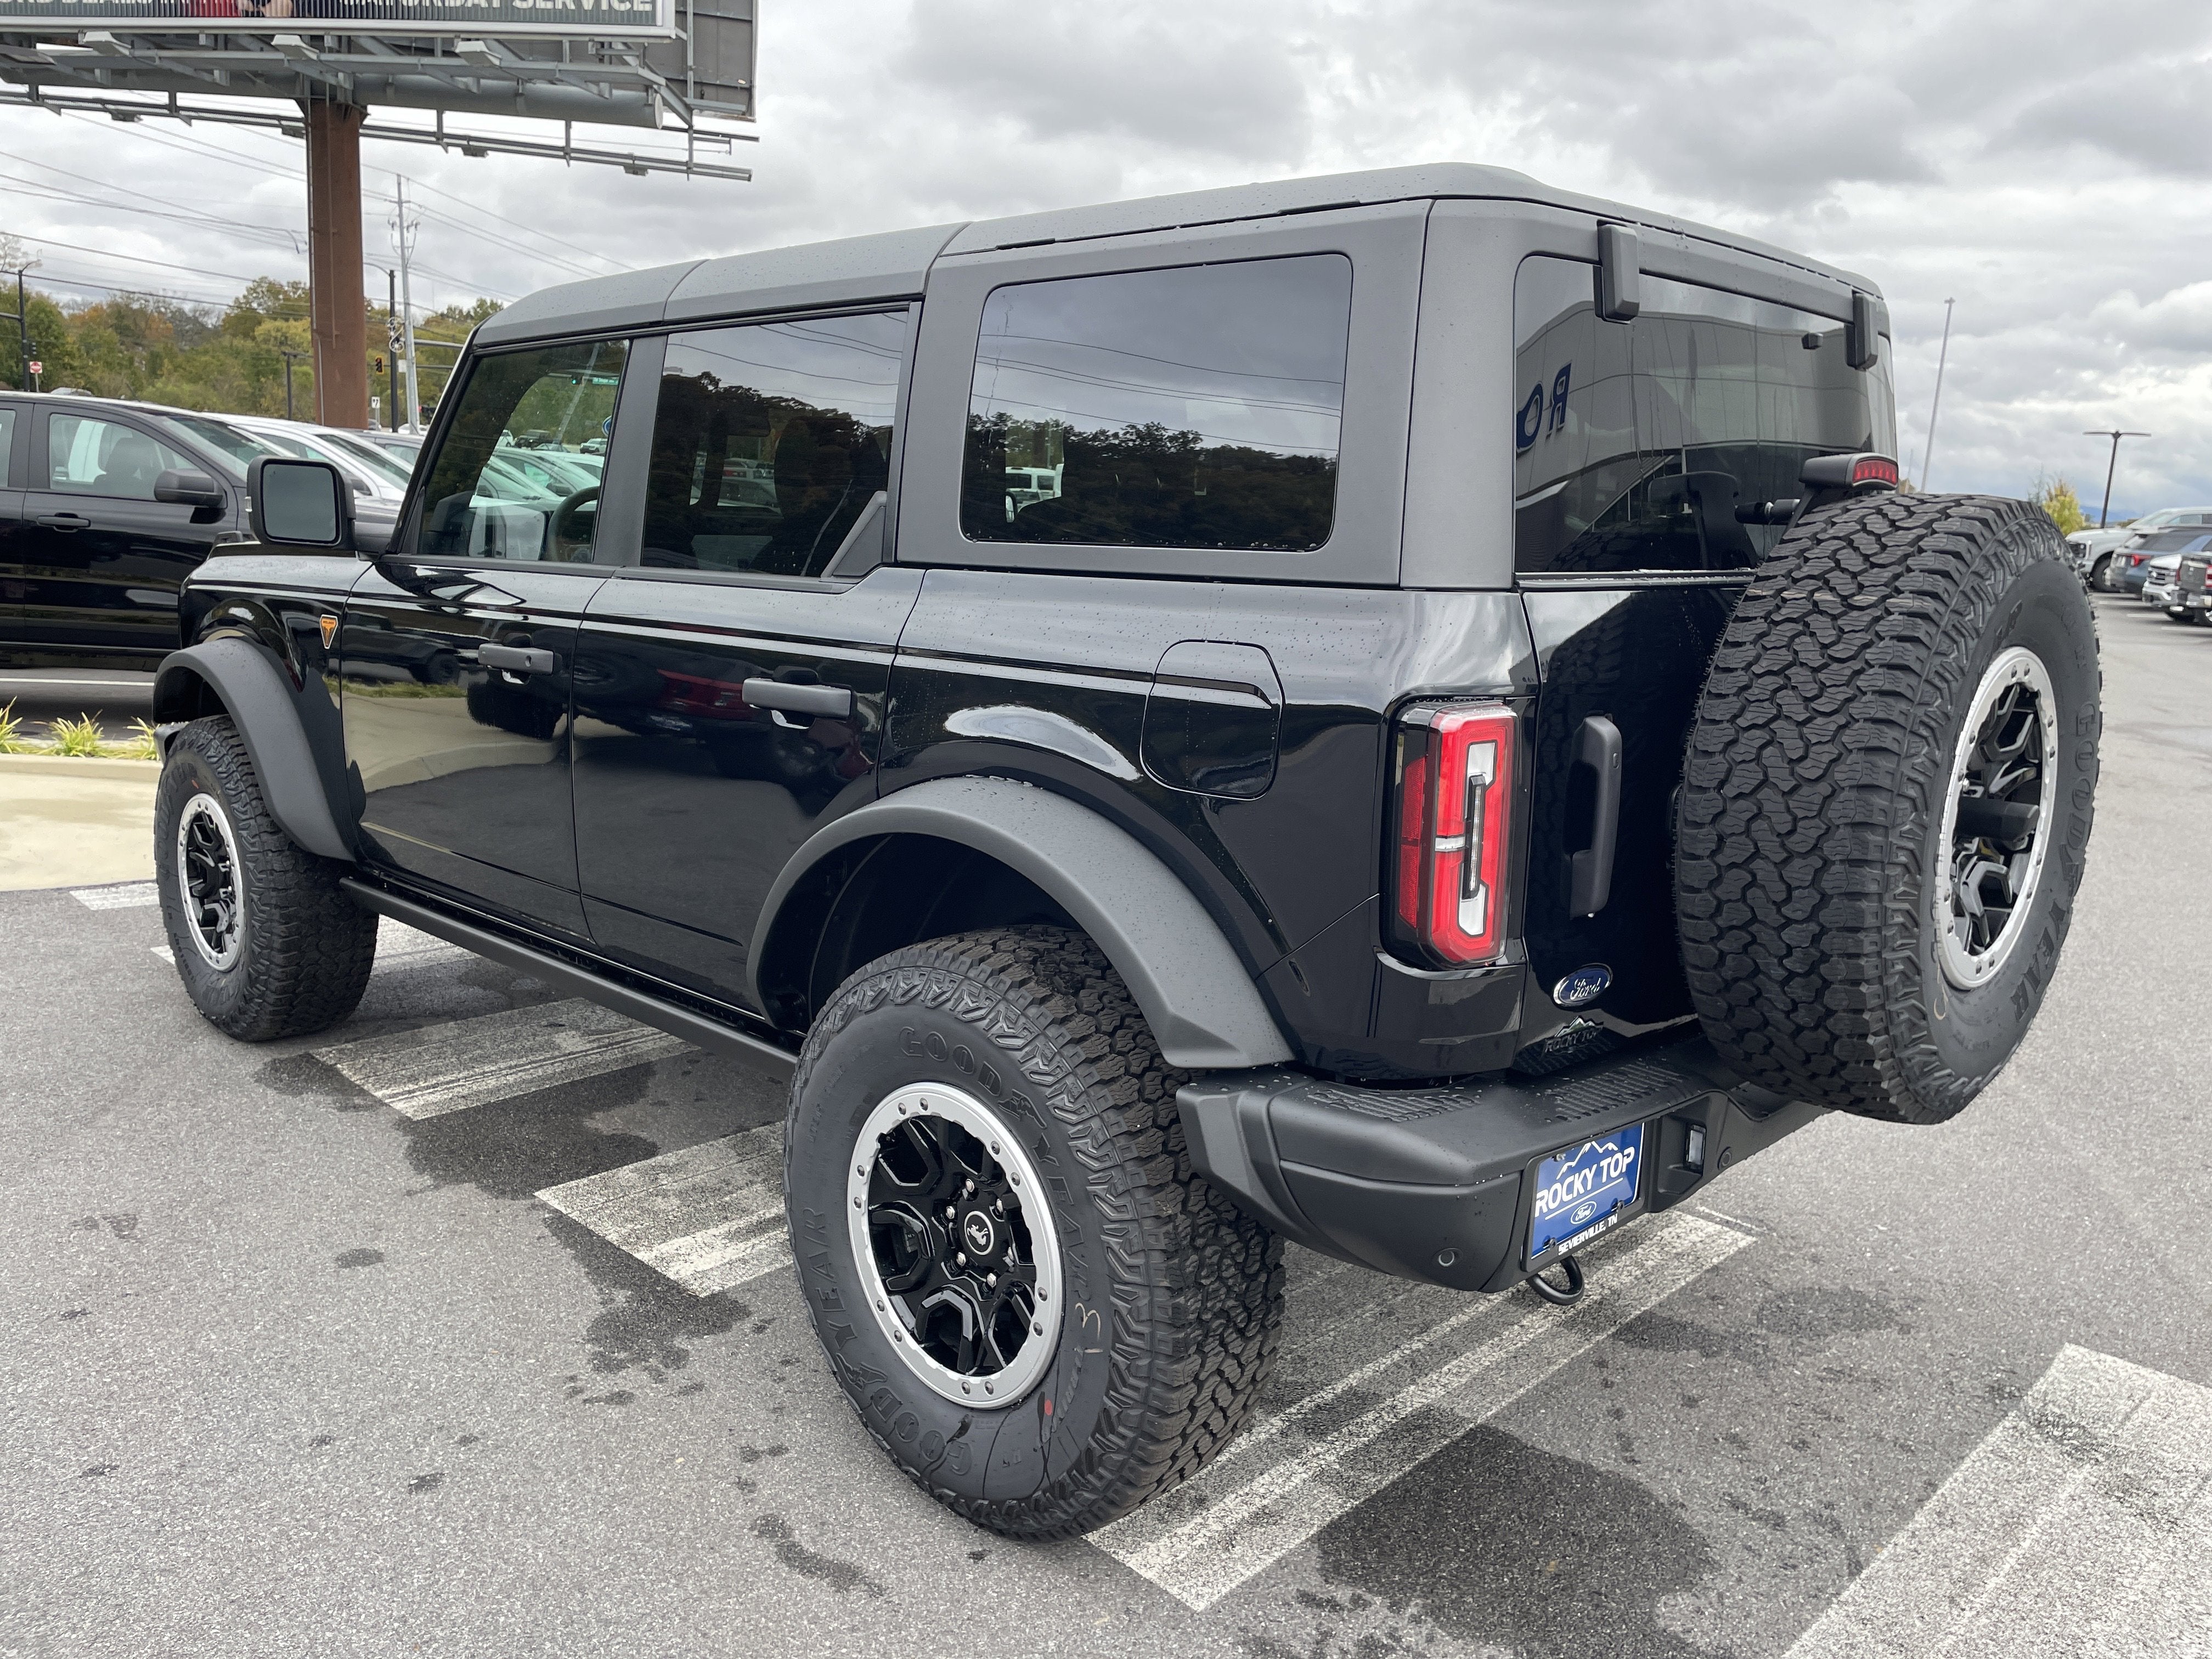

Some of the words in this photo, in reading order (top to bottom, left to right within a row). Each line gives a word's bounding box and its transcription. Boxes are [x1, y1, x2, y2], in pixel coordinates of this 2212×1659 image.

[1570, 977, 1601, 1000] Ford
[1535, 1164, 1597, 1217] ROCKY
[1600, 1146, 1635, 1183] TOP
[1558, 1222, 1606, 1256] SEVIERVILLE,
[1607, 1213, 1618, 1228] TN
